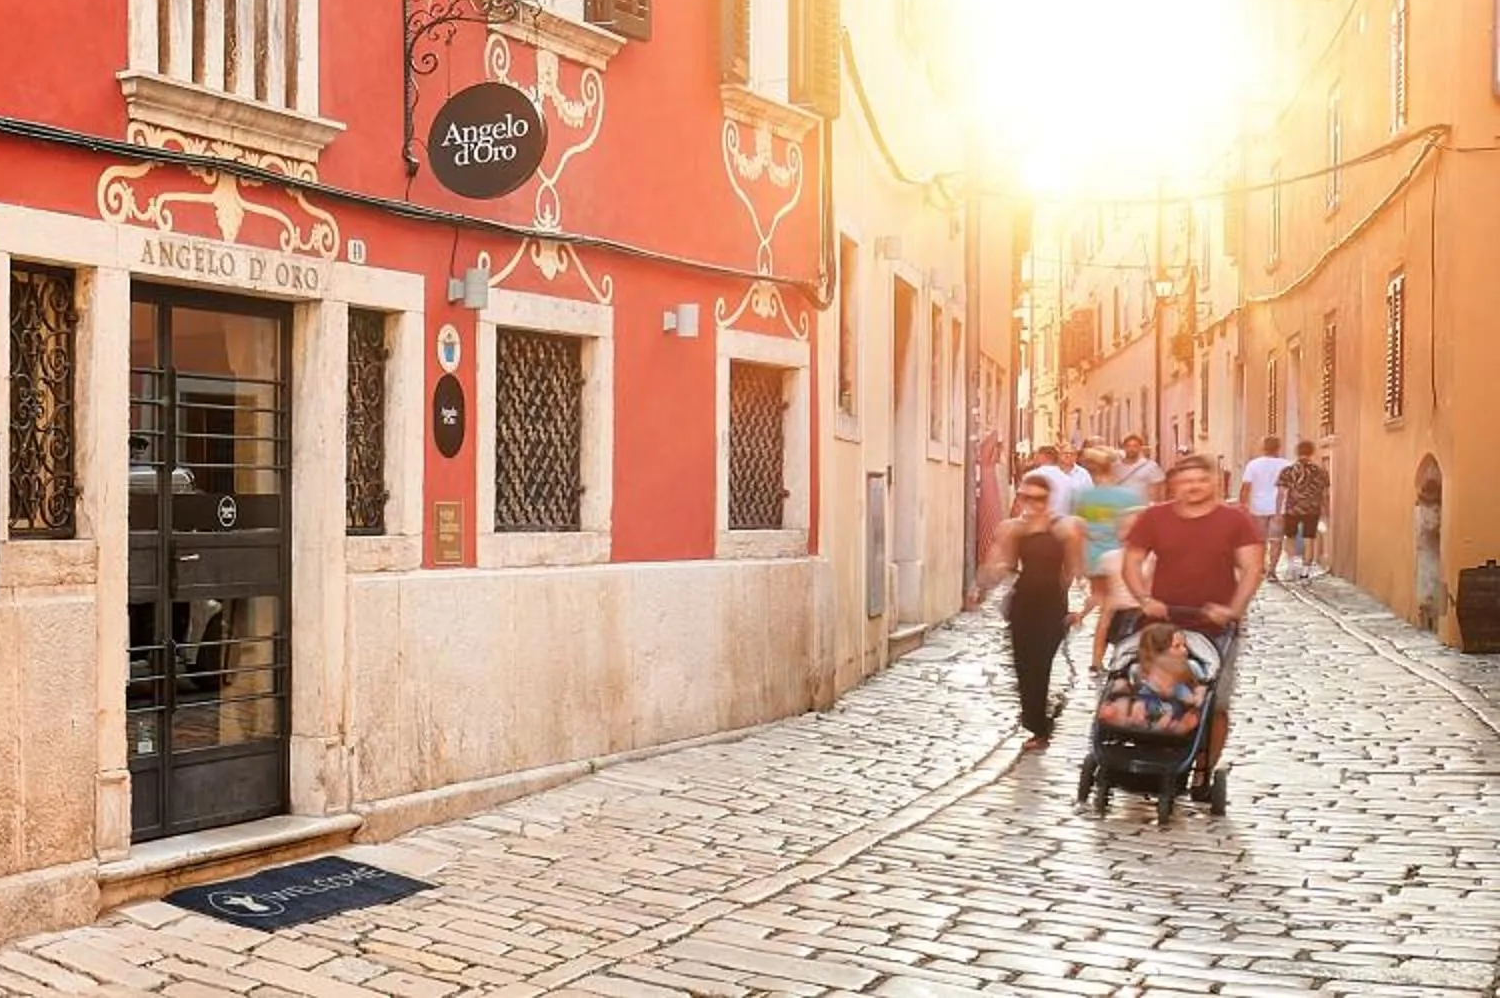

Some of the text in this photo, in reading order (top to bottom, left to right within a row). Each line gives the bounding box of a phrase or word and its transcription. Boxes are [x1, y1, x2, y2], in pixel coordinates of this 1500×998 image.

[441, 113, 528, 147] Angelo
[454, 142, 517, 165] d'Oro
[141, 239, 235, 276] ANGELO
[275, 262, 319, 291] ORO
